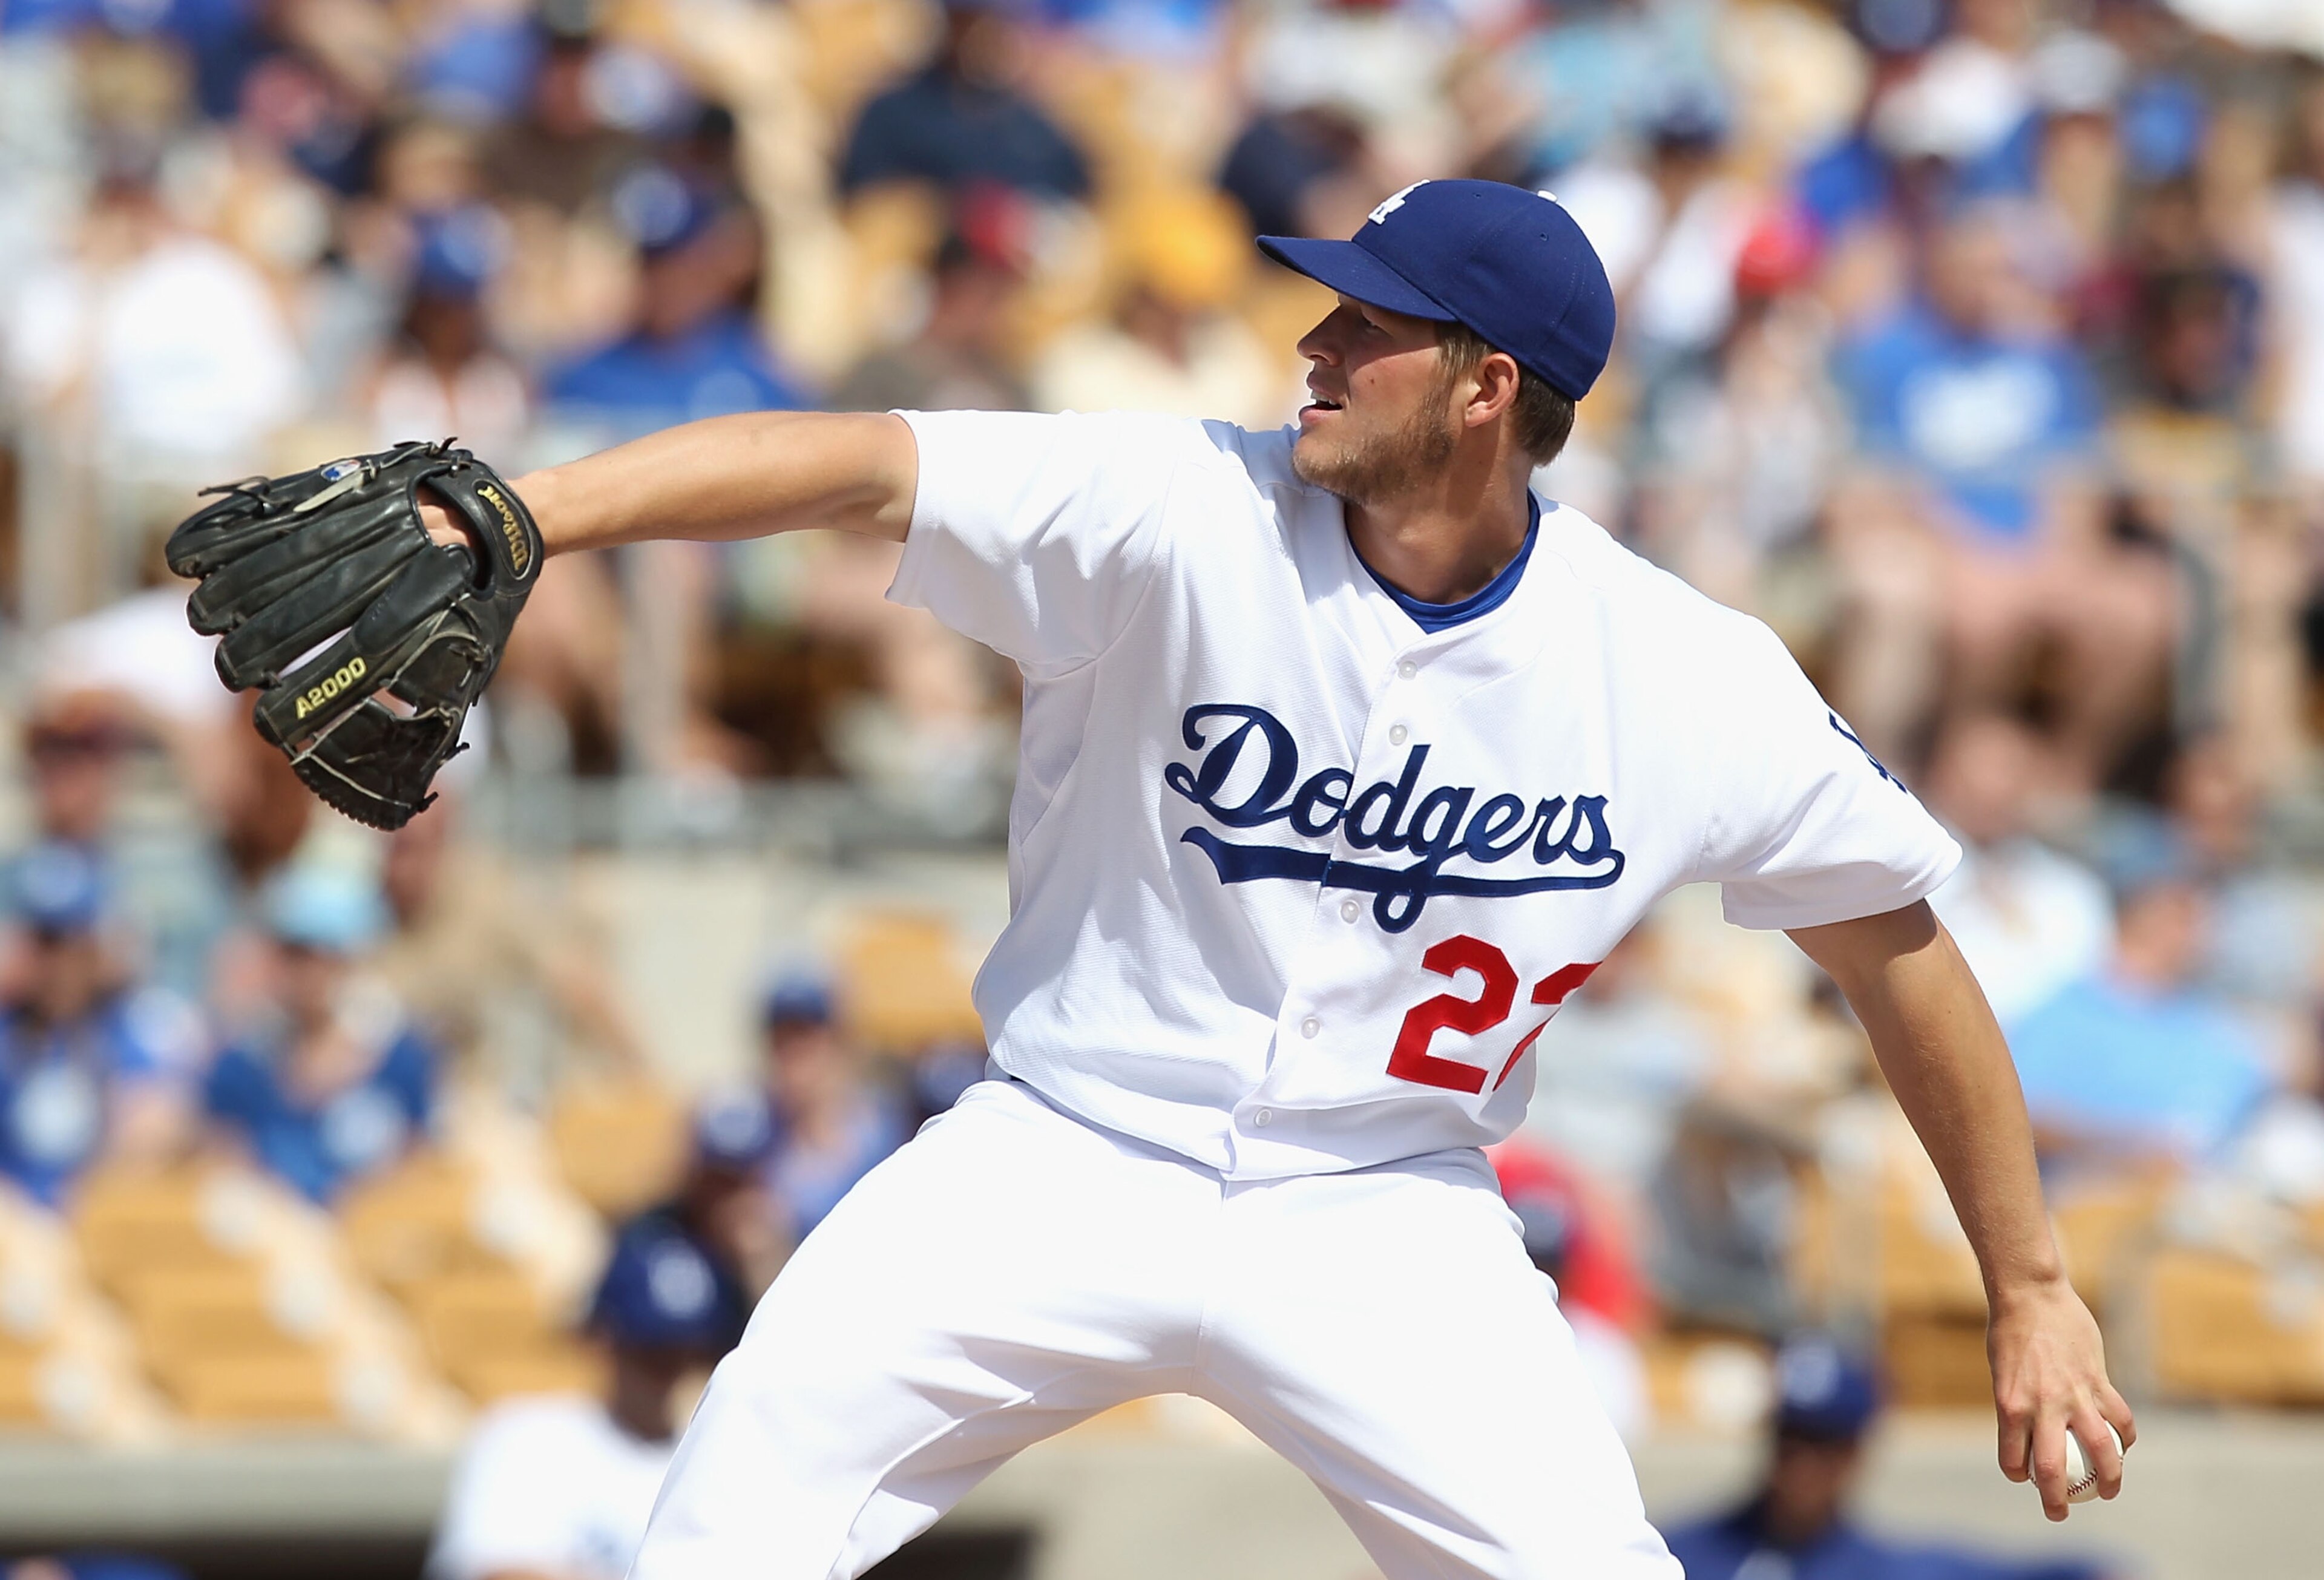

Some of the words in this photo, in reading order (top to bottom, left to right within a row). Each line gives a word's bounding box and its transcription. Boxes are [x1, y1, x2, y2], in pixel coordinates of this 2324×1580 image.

[477, 485, 528, 571] Wilson
[295, 657, 367, 720] A2000
[1164, 704, 1626, 933] Dodgers
